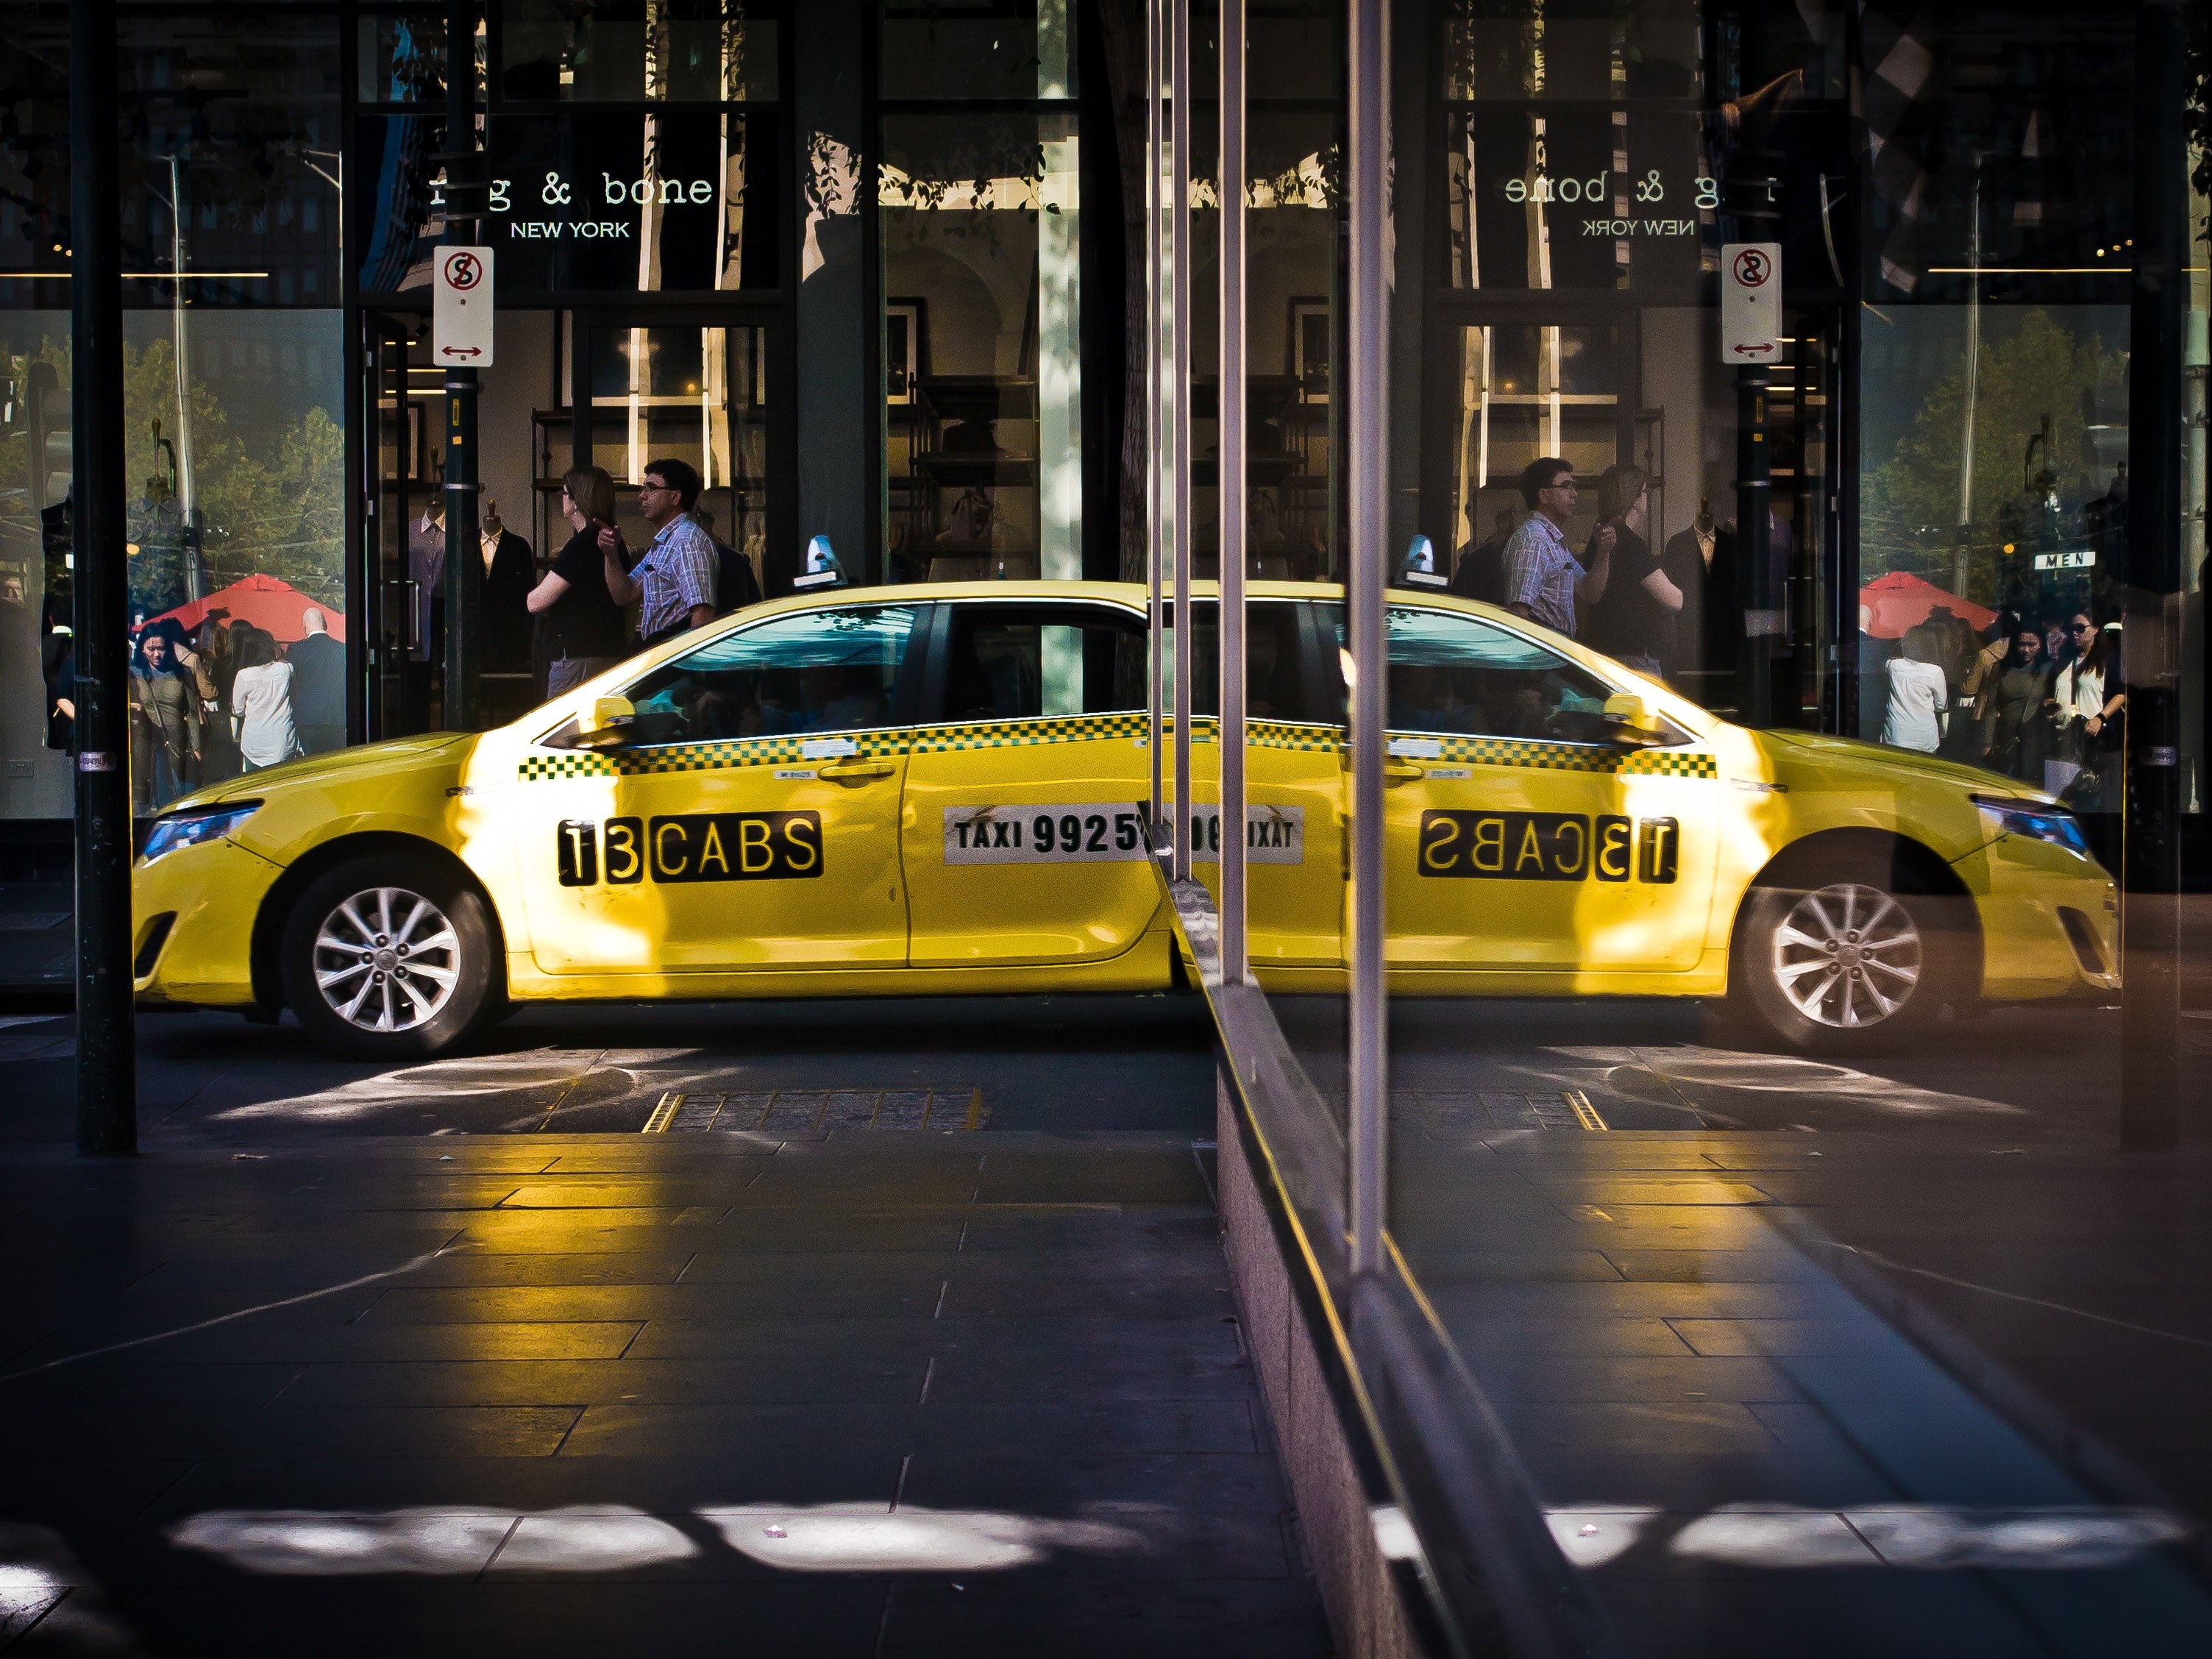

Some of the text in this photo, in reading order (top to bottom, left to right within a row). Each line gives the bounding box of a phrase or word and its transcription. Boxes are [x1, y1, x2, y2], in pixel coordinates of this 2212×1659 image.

[428, 171, 713, 212] rg & bone
[511, 222, 630, 238] NEW YORK
[2046, 553, 2083, 567] MEN
[954, 820, 1023, 848] TAXI
